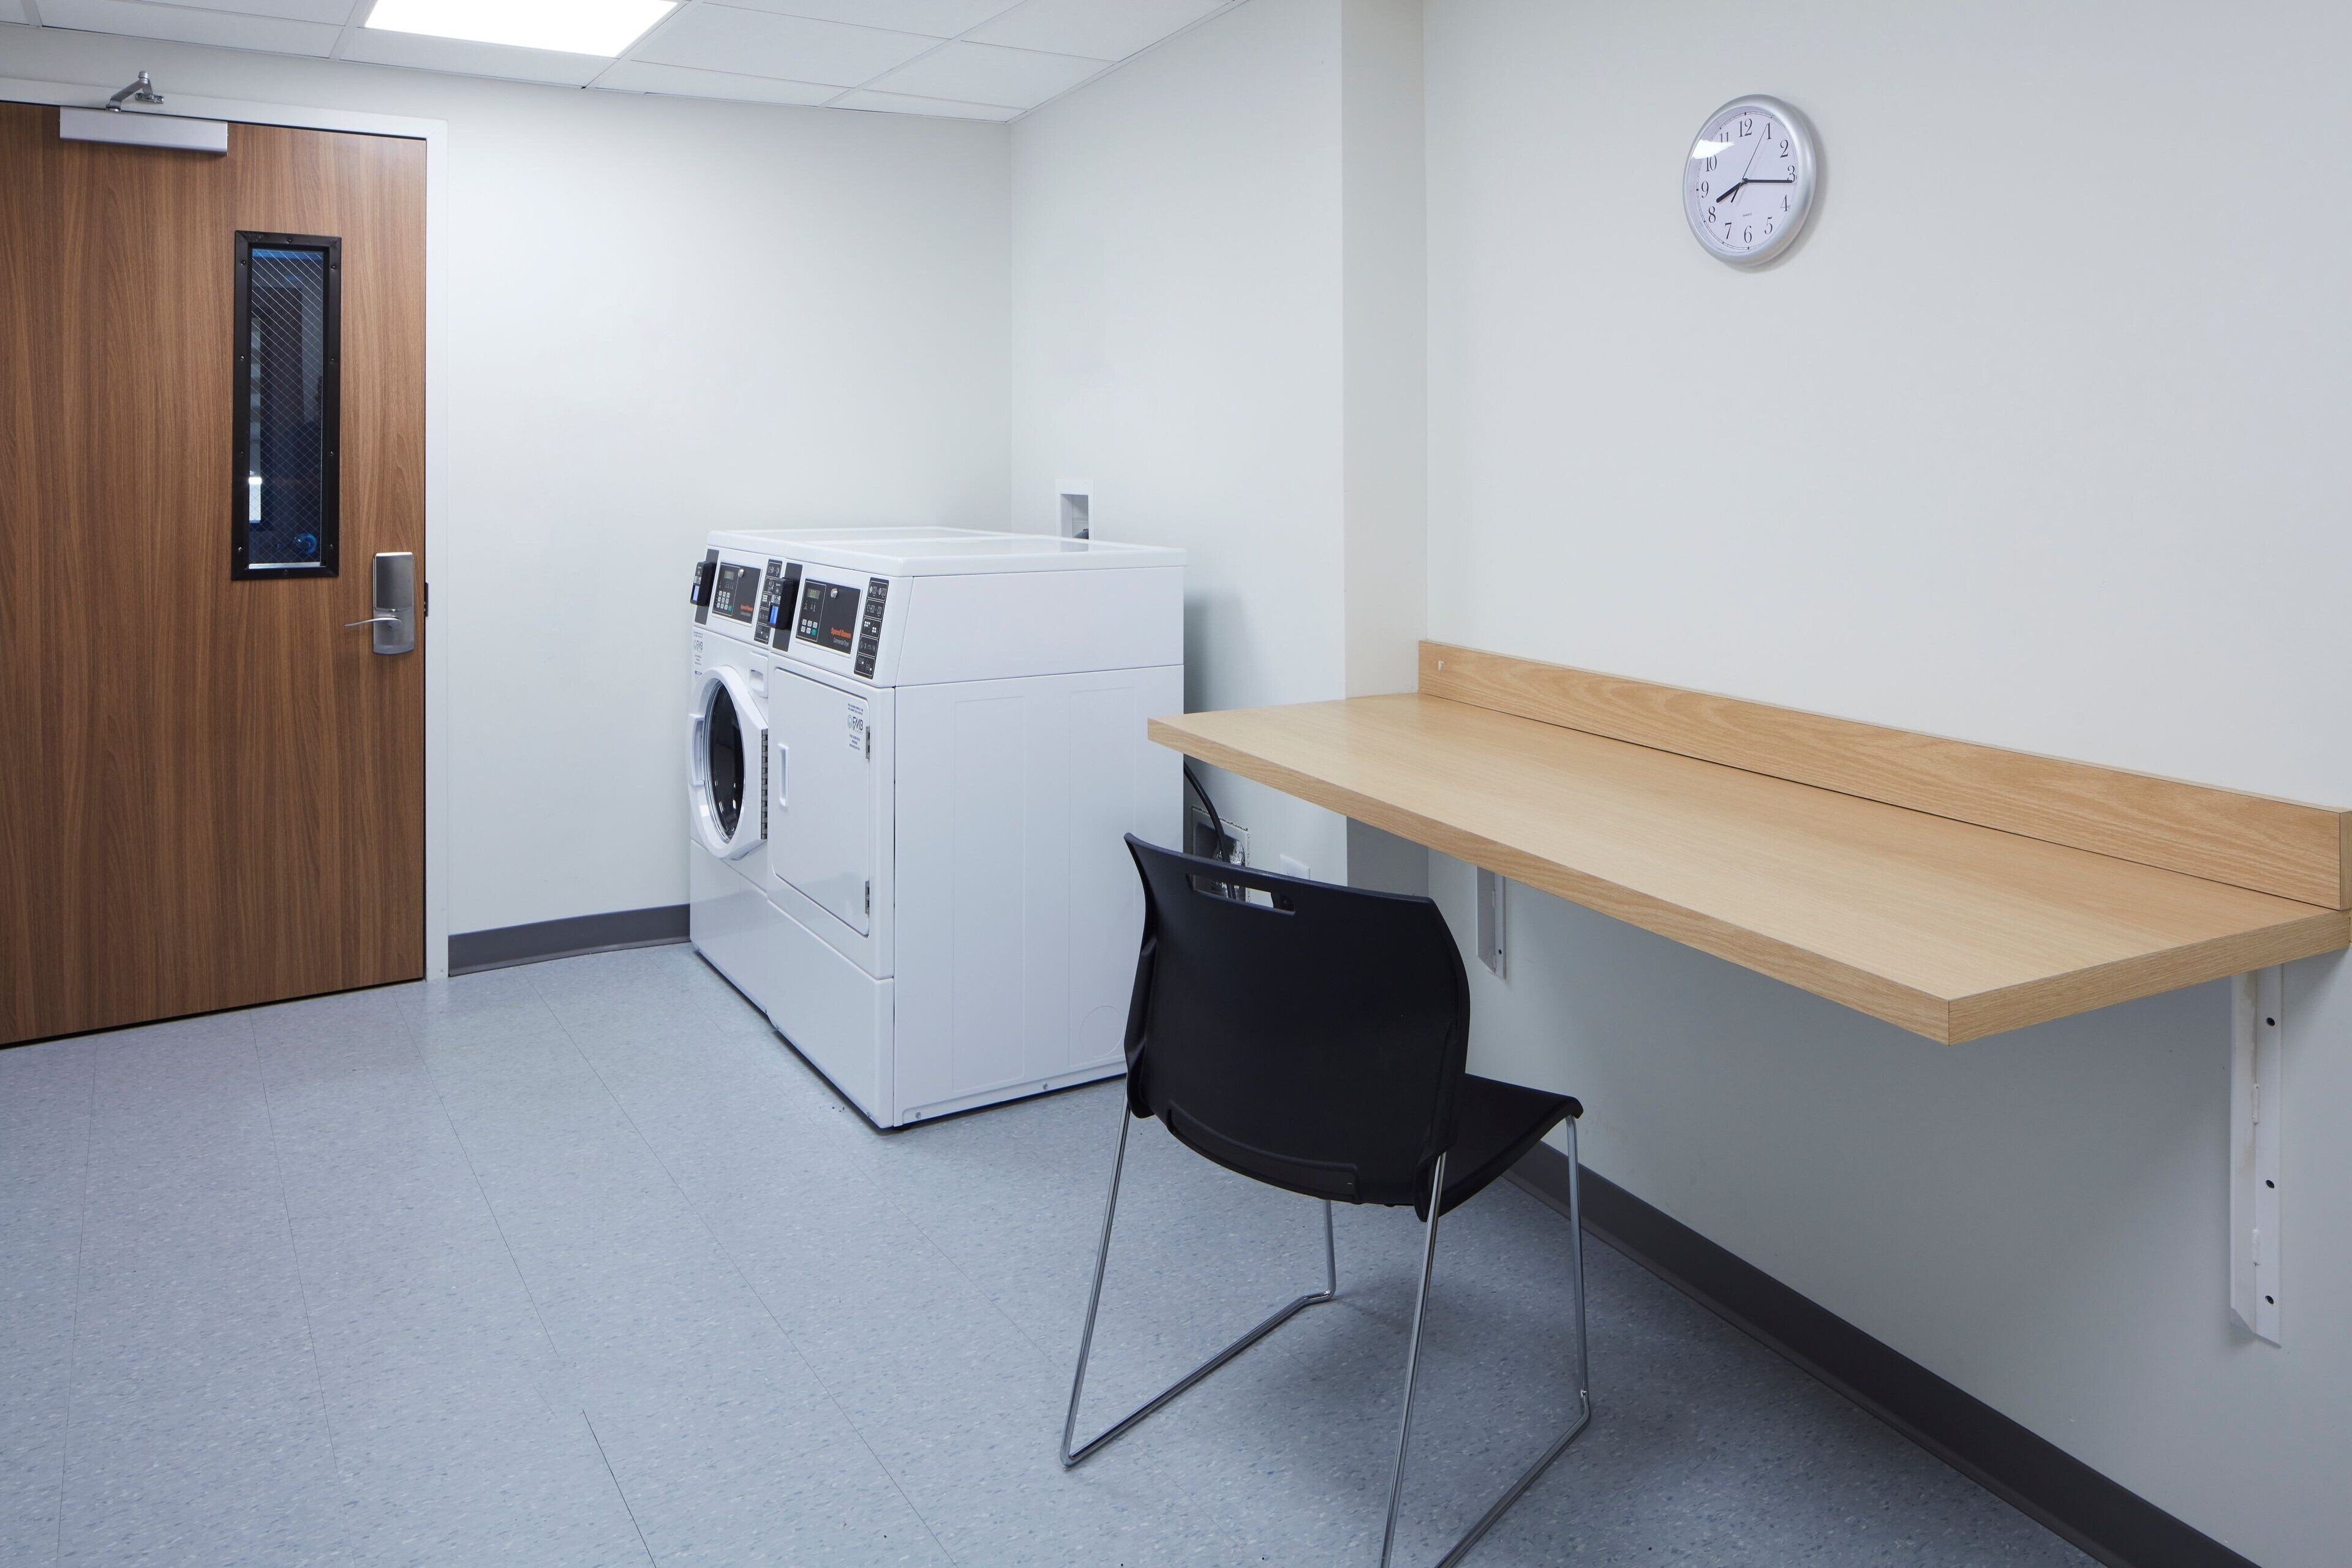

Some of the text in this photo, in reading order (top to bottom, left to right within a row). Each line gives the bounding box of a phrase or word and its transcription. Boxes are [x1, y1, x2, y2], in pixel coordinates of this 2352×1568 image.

[1739, 118, 1752, 137] 12
[1766, 123, 1772, 140] 1
[1720, 132, 1729, 143] 11
[1780, 140, 1789, 158] 2
[1706, 155, 1717, 172] 10
[1787, 165, 1797, 183] 3
[1701, 181, 1709, 198] 9
[1780, 195, 1790, 212] 4
[1708, 206, 1716, 223] 8
[1725, 222, 1732, 239] 7
[1744, 225, 1752, 243] 6
[1765, 217, 1773, 235] 5
